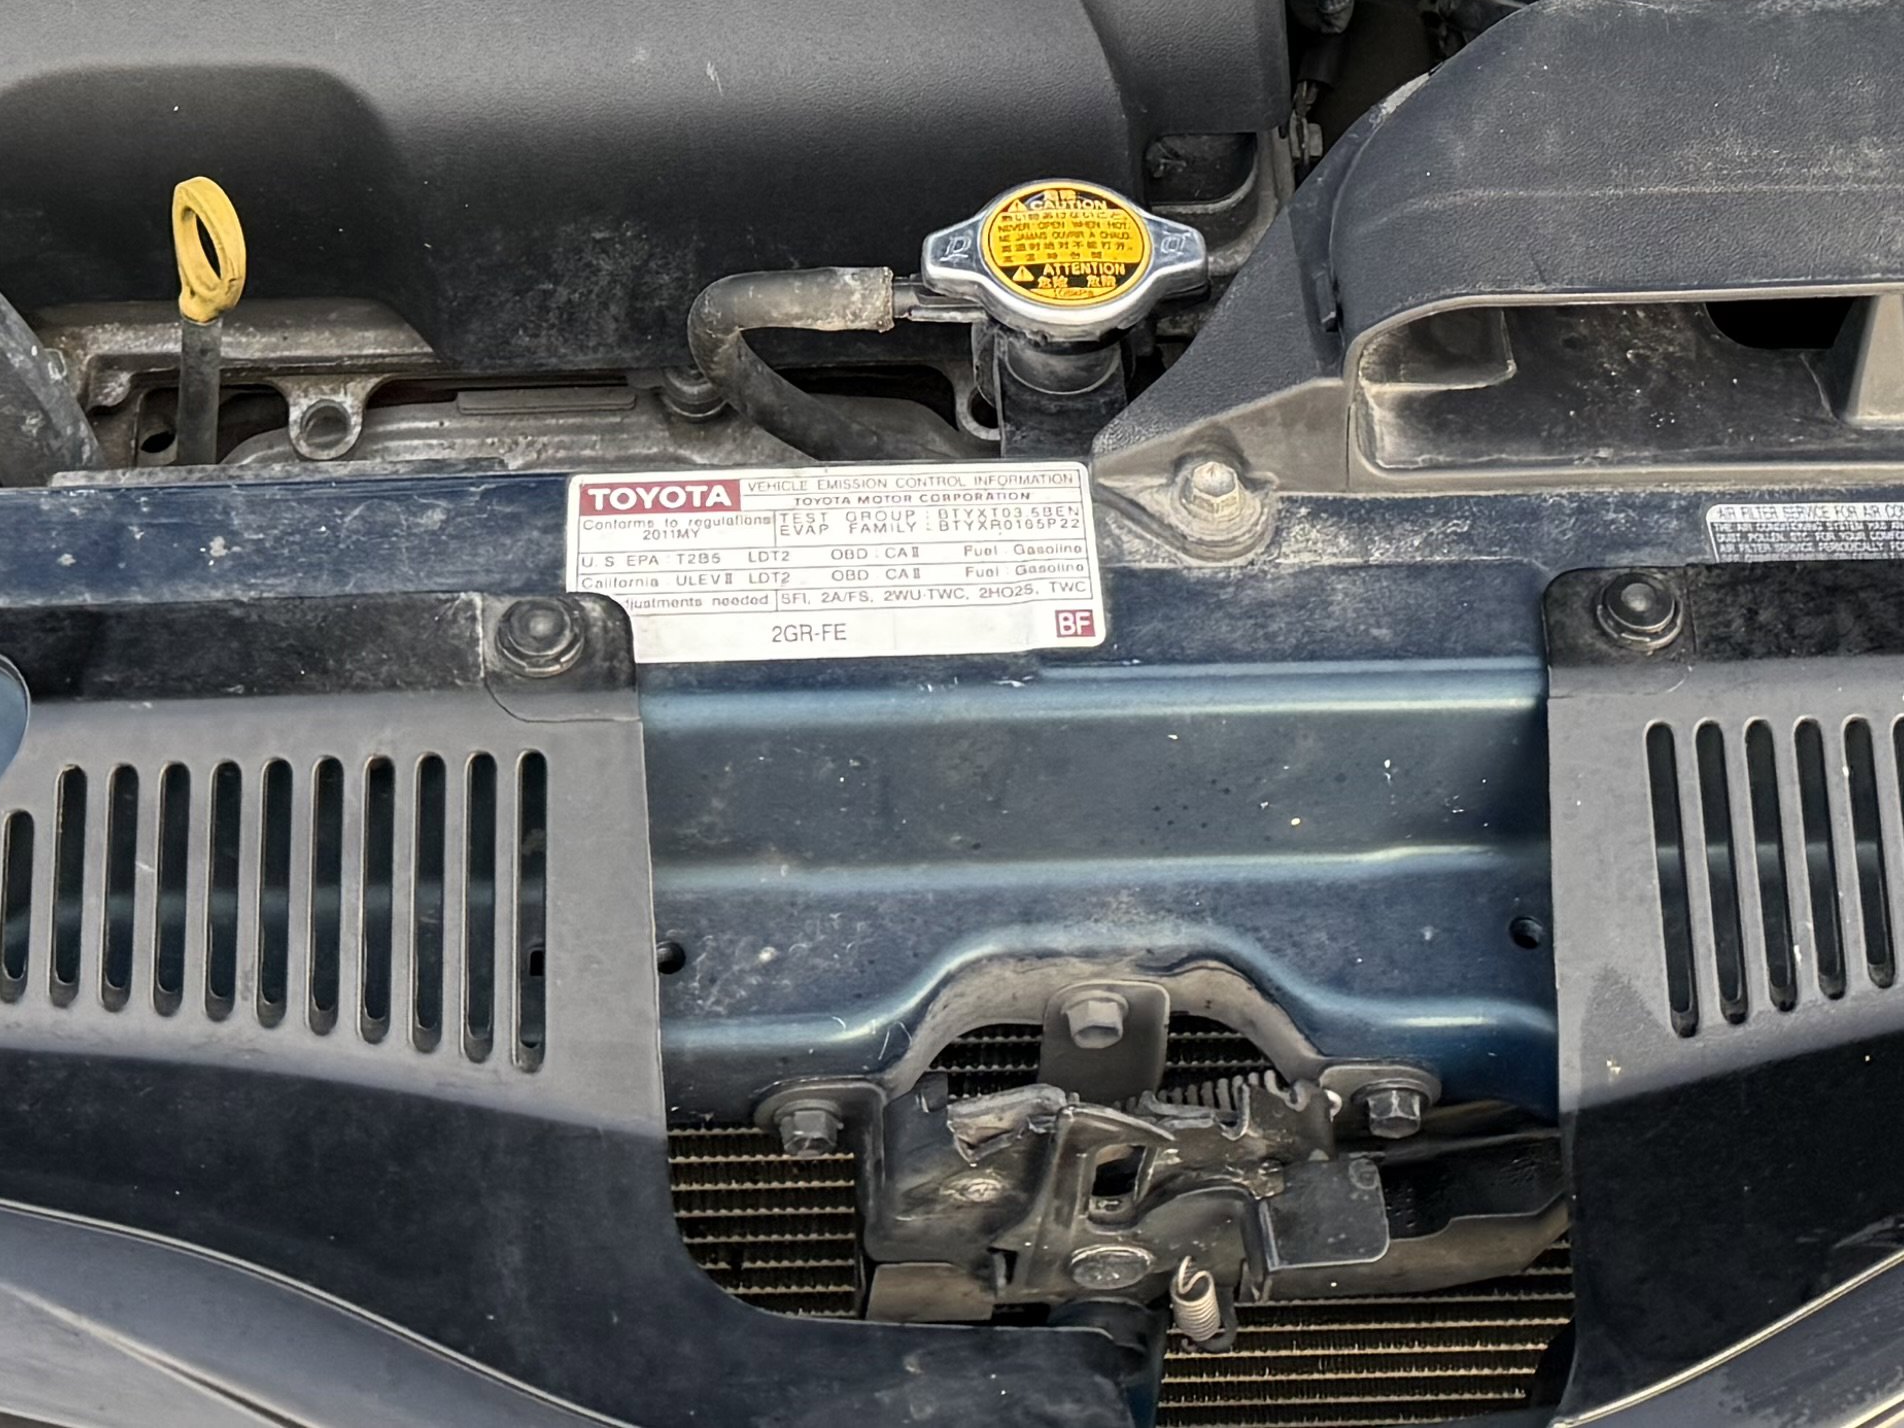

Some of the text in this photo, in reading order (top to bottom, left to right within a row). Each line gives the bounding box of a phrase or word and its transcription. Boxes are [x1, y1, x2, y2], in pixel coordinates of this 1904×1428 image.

[1029, 199, 1108, 211] CAUTION
[1042, 262, 1126, 276] ATTENTION
[747, 473, 1075, 493] VEHICLE EMISSION CONTROL INFORMATION
[587, 484, 733, 512] TOYOTA
[794, 492, 1032, 507] TOYOTA MOTOR CORPORATION
[780, 512, 829, 524] TEST
[845, 509, 917, 523] GROUP
[1716, 507, 1737, 520] AIR
[1739, 506, 1778, 520] FILTER
[1782, 505, 1832, 520] SERVICE
[1833, 505, 1858, 519] FOR
[1862, 505, 1882, 519] AIR
[582, 514, 773, 531] Conforms to regulations
[780, 523, 830, 536] EVAP
[848, 519, 917, 534] FAMILY
[642, 528, 702, 541] 2011MY
[626, 553, 660, 566] EPA
[747, 549, 791, 563] LDT2
[830, 547, 869, 561] OBD
[963, 544, 998, 557] Fuel
[1012, 542, 1083, 557] Gasoline
[581, 576, 660, 590] California
[748, 570, 791, 585] LDT2
[830, 568, 870, 582] OBD
[965, 565, 1000, 578] Fuel
[1014, 562, 1085, 577] Gasoline
[711, 594, 769, 608] needed
[1048, 580, 1088, 594] TWC
[770, 611, 1093, 644] 2GR-FE BF
